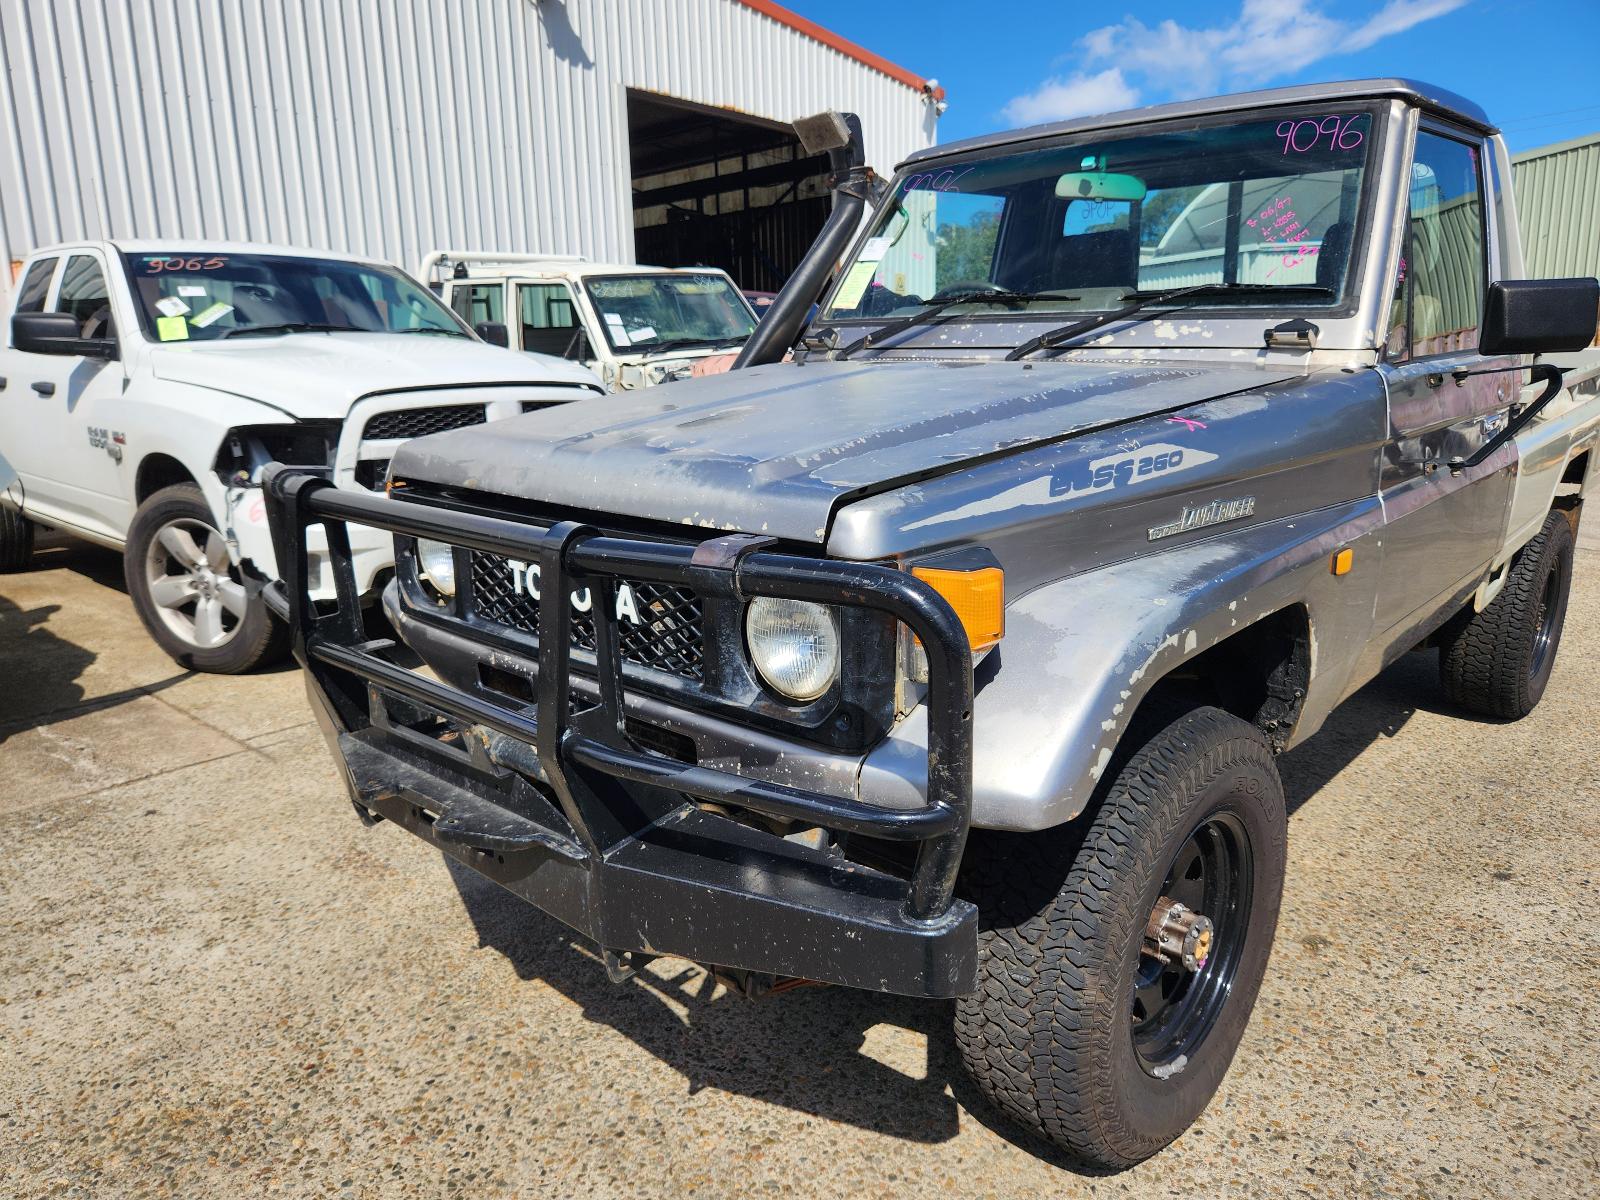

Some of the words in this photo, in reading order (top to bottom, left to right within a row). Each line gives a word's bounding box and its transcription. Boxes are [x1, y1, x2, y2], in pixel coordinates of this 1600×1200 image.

[1276, 114, 1363, 155] 9096
[145, 256, 230, 274] 9065
[1137, 450, 1184, 476] 260
[508, 559, 642, 625] TOOA
